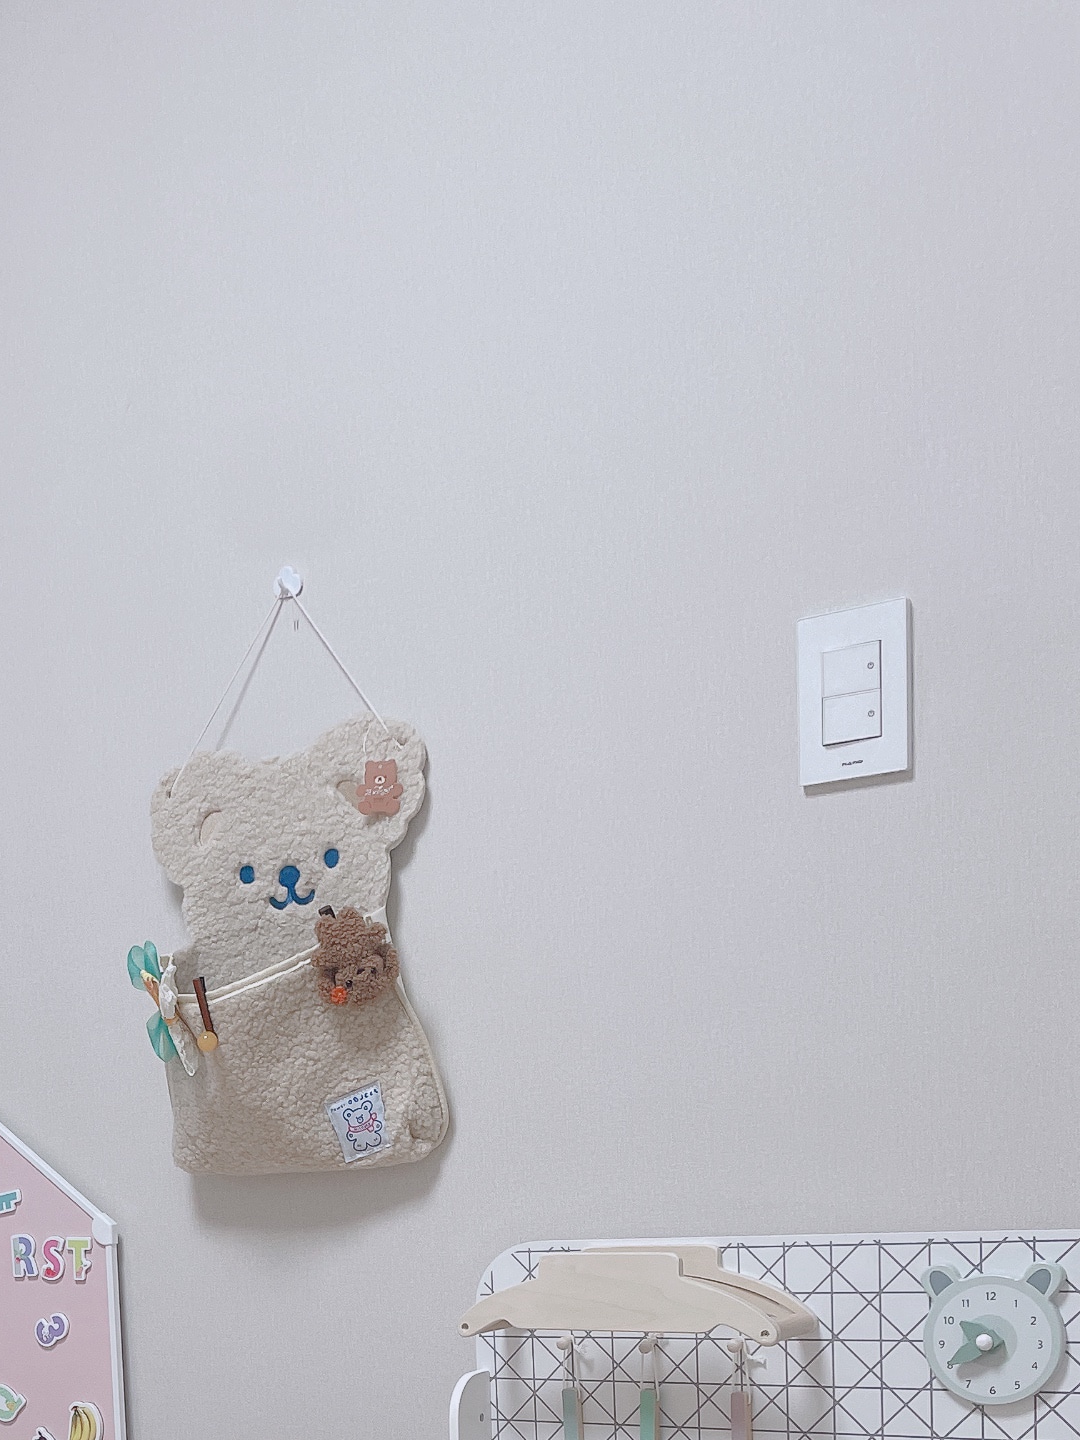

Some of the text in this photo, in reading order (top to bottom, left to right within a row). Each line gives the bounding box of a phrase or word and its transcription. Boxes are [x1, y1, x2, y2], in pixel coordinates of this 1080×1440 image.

[12, 1235, 93, 1281] RST
[986, 1292, 997, 1301] 12
[962, 1299, 970, 1308] 11
[943, 1316, 955, 1325] 10
[1030, 1316, 1037, 1326] 2
[938, 1340, 946, 1349] 9
[1037, 1340, 1044, 1350] 3
[1031, 1362, 1038, 1370] 4
[965, 1380, 972, 1389] 7
[1014, 1381, 1021, 1390] 5
[989, 1386, 997, 1395] 6
